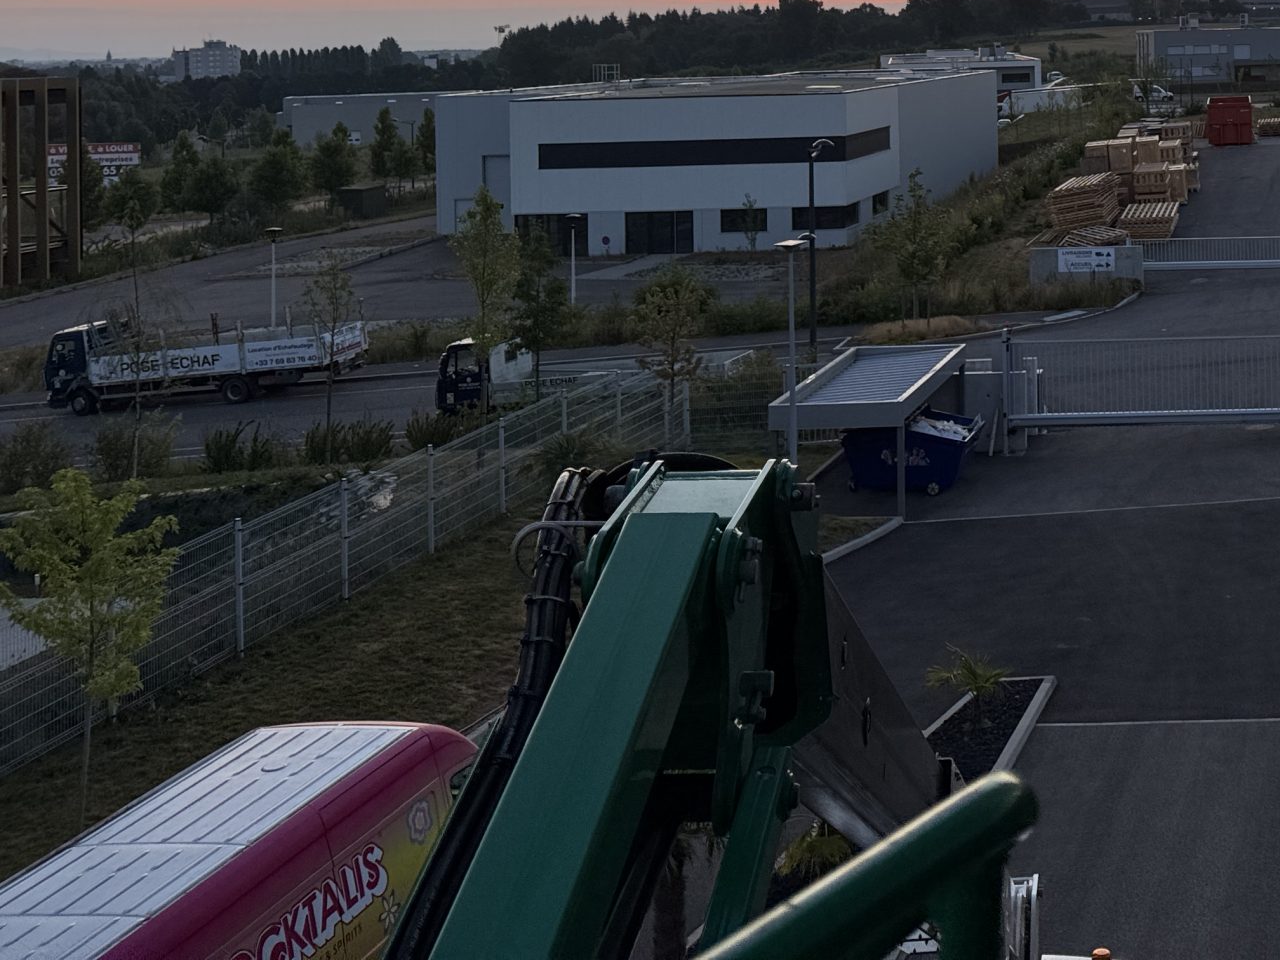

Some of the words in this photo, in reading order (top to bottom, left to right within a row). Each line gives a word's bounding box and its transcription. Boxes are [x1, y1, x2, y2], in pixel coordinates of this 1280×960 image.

[105, 144, 134, 152] LOUER
[119, 359, 160, 374] POSE
[171, 354, 220, 370] ECHAF
[228, 842, 389, 960] CKTALIS
